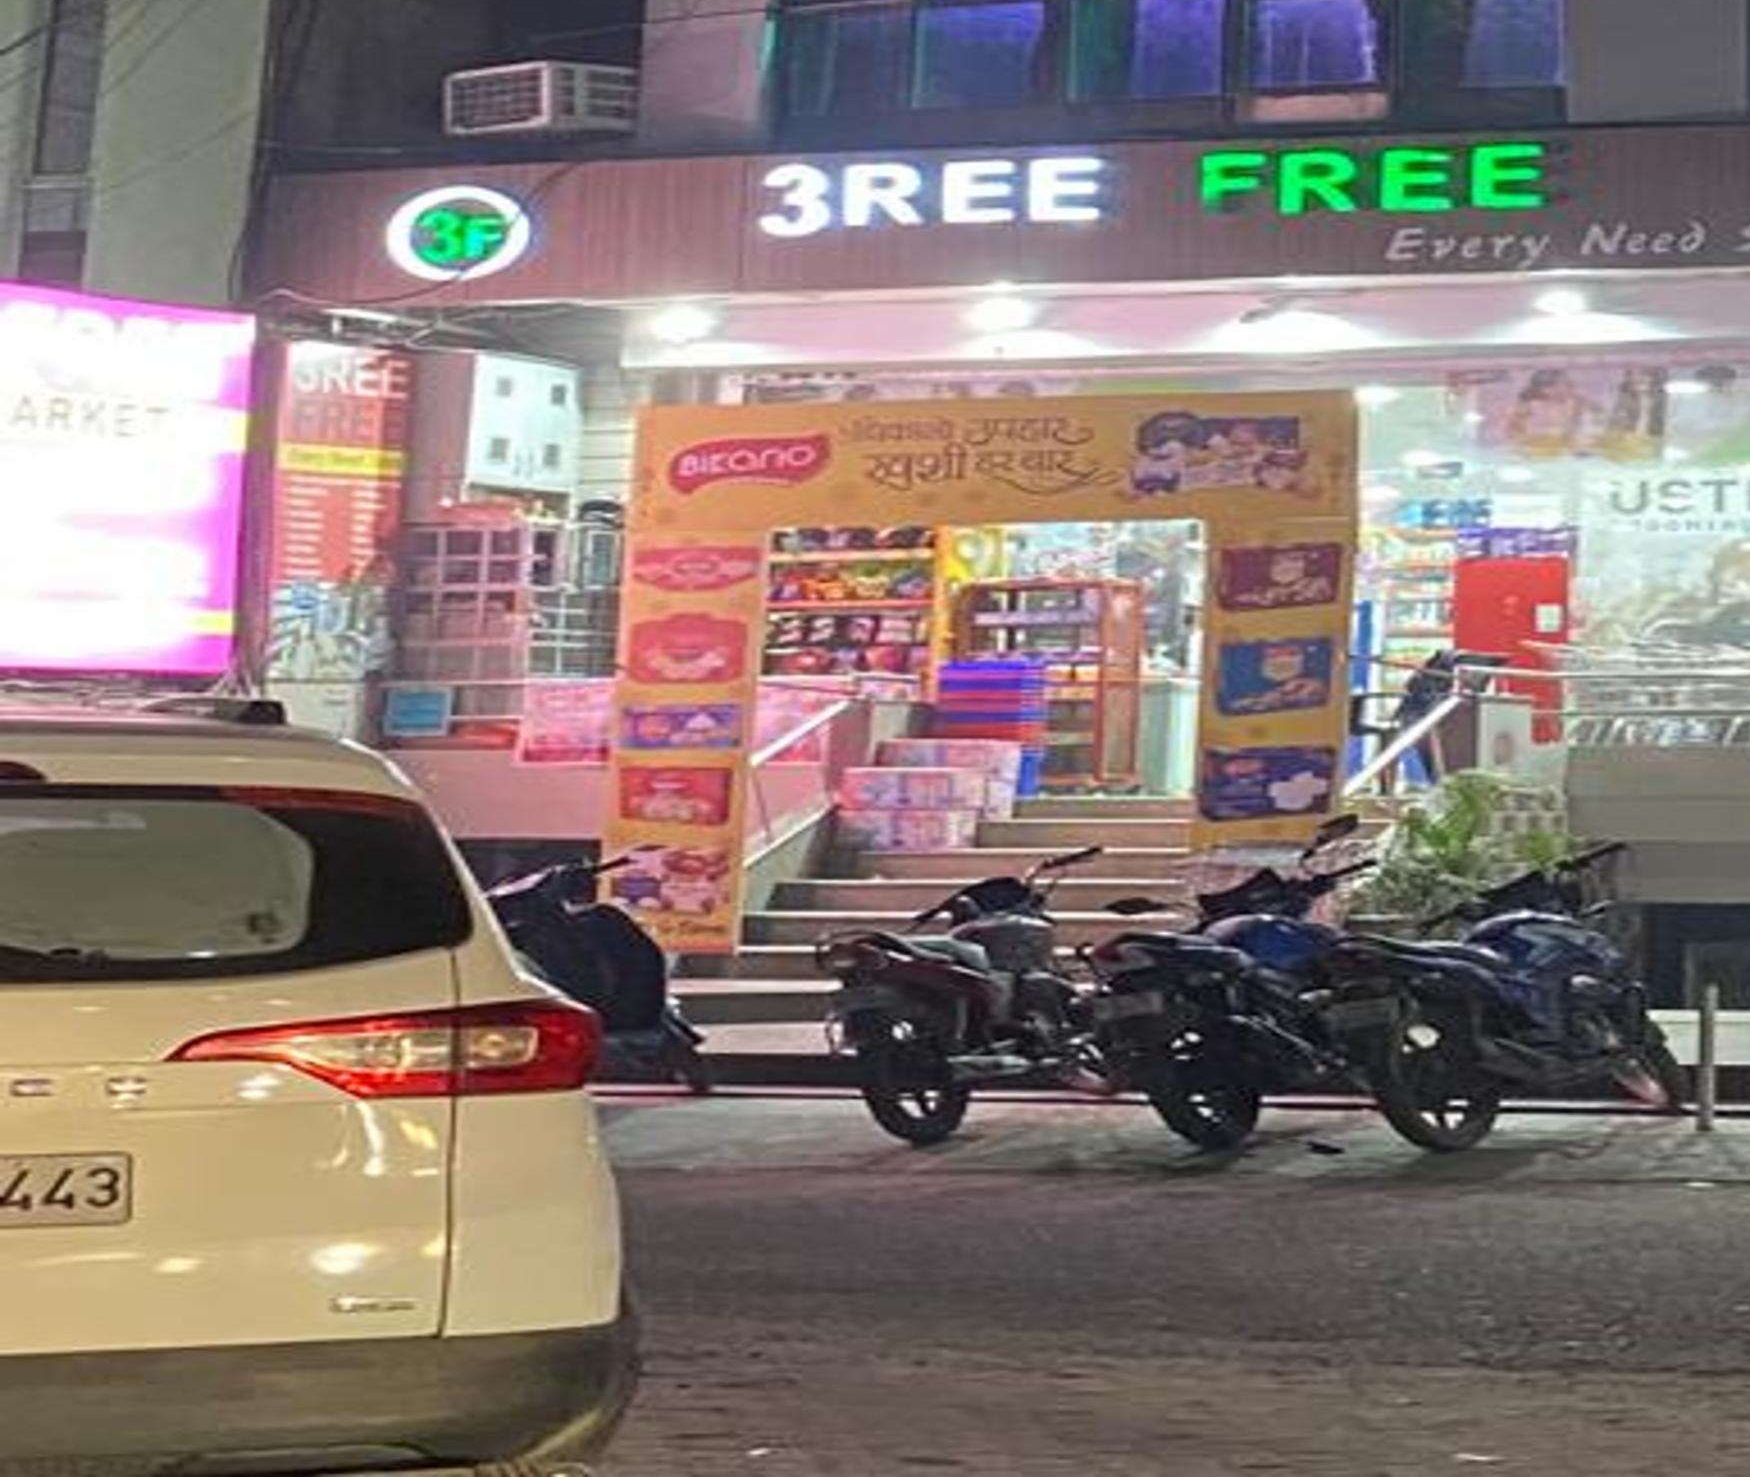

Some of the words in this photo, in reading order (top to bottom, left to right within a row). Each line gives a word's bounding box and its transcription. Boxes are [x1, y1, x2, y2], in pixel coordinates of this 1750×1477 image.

[759, 156, 1102, 237] 3REE
[1199, 142, 1546, 215] FREE
[1384, 226, 1550, 268] Every
[1579, 222, 1708, 257] Need
[0, 1167, 120, 1212] 443
